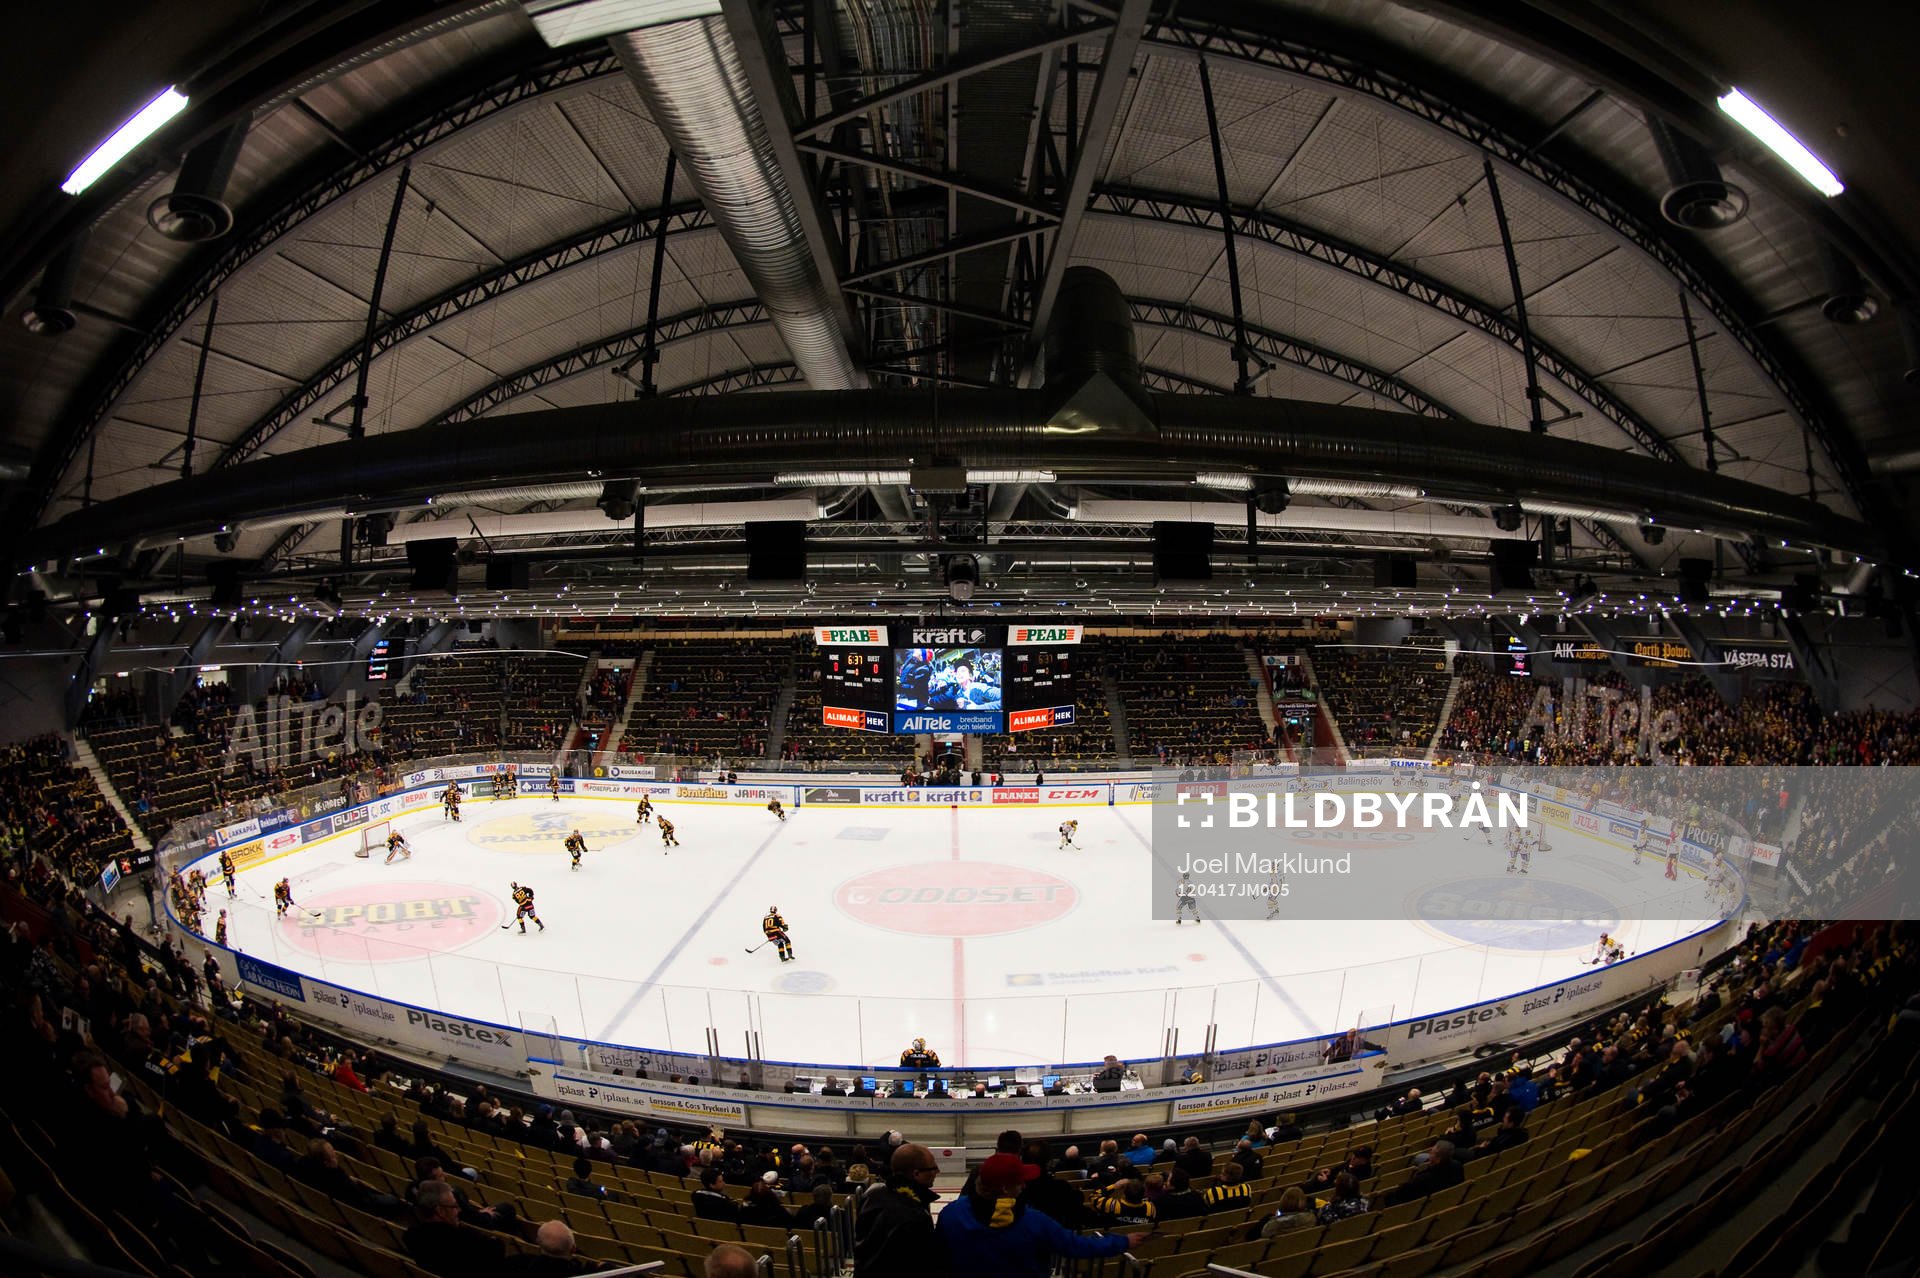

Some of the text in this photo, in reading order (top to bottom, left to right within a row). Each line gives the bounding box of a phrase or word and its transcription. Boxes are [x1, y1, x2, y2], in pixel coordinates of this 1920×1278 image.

[829, 630, 870, 642] PEAB
[913, 629, 966, 643] kraft
[1026, 629, 1068, 641] PEAB
[1554, 643, 1574, 658] AIK
[1634, 643, 1692, 660] North Power
[848, 655, 863, 665] 6:37
[1724, 649, 1794, 669] VÄSTRA STÅ
[827, 712, 884, 726] ALIMAK HEK
[902, 716, 951, 730] AllTele
[1013, 711, 1071, 726] ALIMAK HEK
[1519, 677, 1681, 762] AllTele
[223, 690, 383, 775] AllTele
[411, 772, 425, 784] SOS
[1337, 776, 1383, 787] Ballingslöv
[405, 791, 428, 803] REPAY
[631, 786, 670, 794] INTERSPORT
[864, 790, 904, 802] kraft
[926, 790, 967, 802] kraft
[993, 791, 1039, 800] FRANKE
[1048, 789, 1099, 799] CCM
[380, 802, 391, 814] SSC
[1542, 804, 1570, 820] engcon
[334, 807, 368, 826] GUIDE
[1575, 814, 1598, 831] JULA
[1687, 826, 1725, 849] PROFIX
[231, 842, 262, 860] BROKK
[875, 884, 1065, 904] ODDSET
[298, 896, 481, 928] SPORT
[312, 987, 395, 1022] iplast iplast.se
[1522, 996, 1551, 1015] iplast
[406, 1009, 512, 1048] Plastex
[1408, 1003, 1510, 1039] Plastex
[600, 1054, 634, 1069] iplast
[558, 1083, 645, 1106] iplast iplast.se
[1272, 1080, 1359, 1104] iplast iplast.se
[649, 1096, 676, 1108] Larsson
[702, 1103, 728, 1114] Tryckeri
[730, 1106, 741, 1115] AB
[1177, 1100, 1206, 1111] Larsson
[1232, 1093, 1258, 1105] Tryckeri
[1259, 1092, 1269, 1100] AB
